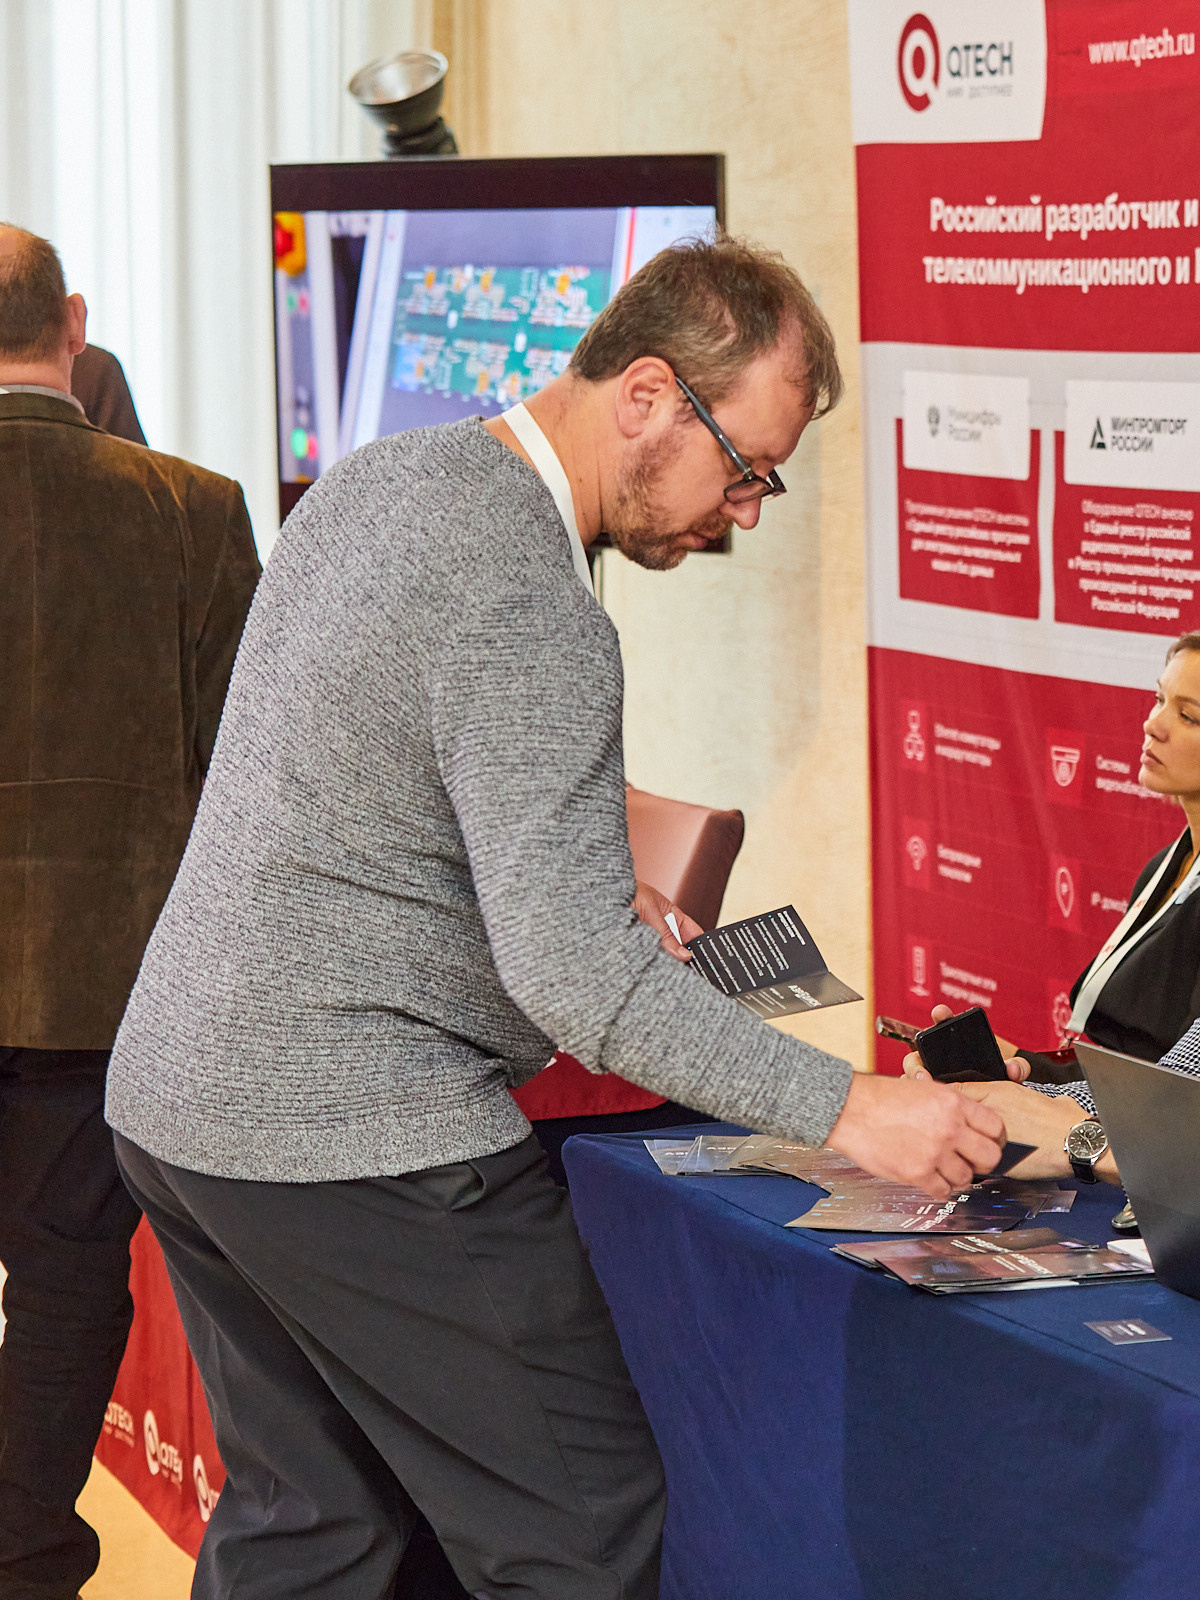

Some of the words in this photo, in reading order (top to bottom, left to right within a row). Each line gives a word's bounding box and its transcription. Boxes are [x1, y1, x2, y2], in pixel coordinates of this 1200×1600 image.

[947, 42, 1013, 77] QTECH
[1088, 28, 1195, 67] www.qtech.ru
[930, 195, 1042, 233] Российский
[1045, 192, 1180, 241] разработчик
[1184, 199, 1199, 227] и
[923, 256, 1172, 295] телекоммуникационного
[1175, 256, 1190, 284] и
[1111, 417, 1187, 435] МИНПРОМТОРГ
[1111, 435, 1153, 452] РОССИИ
